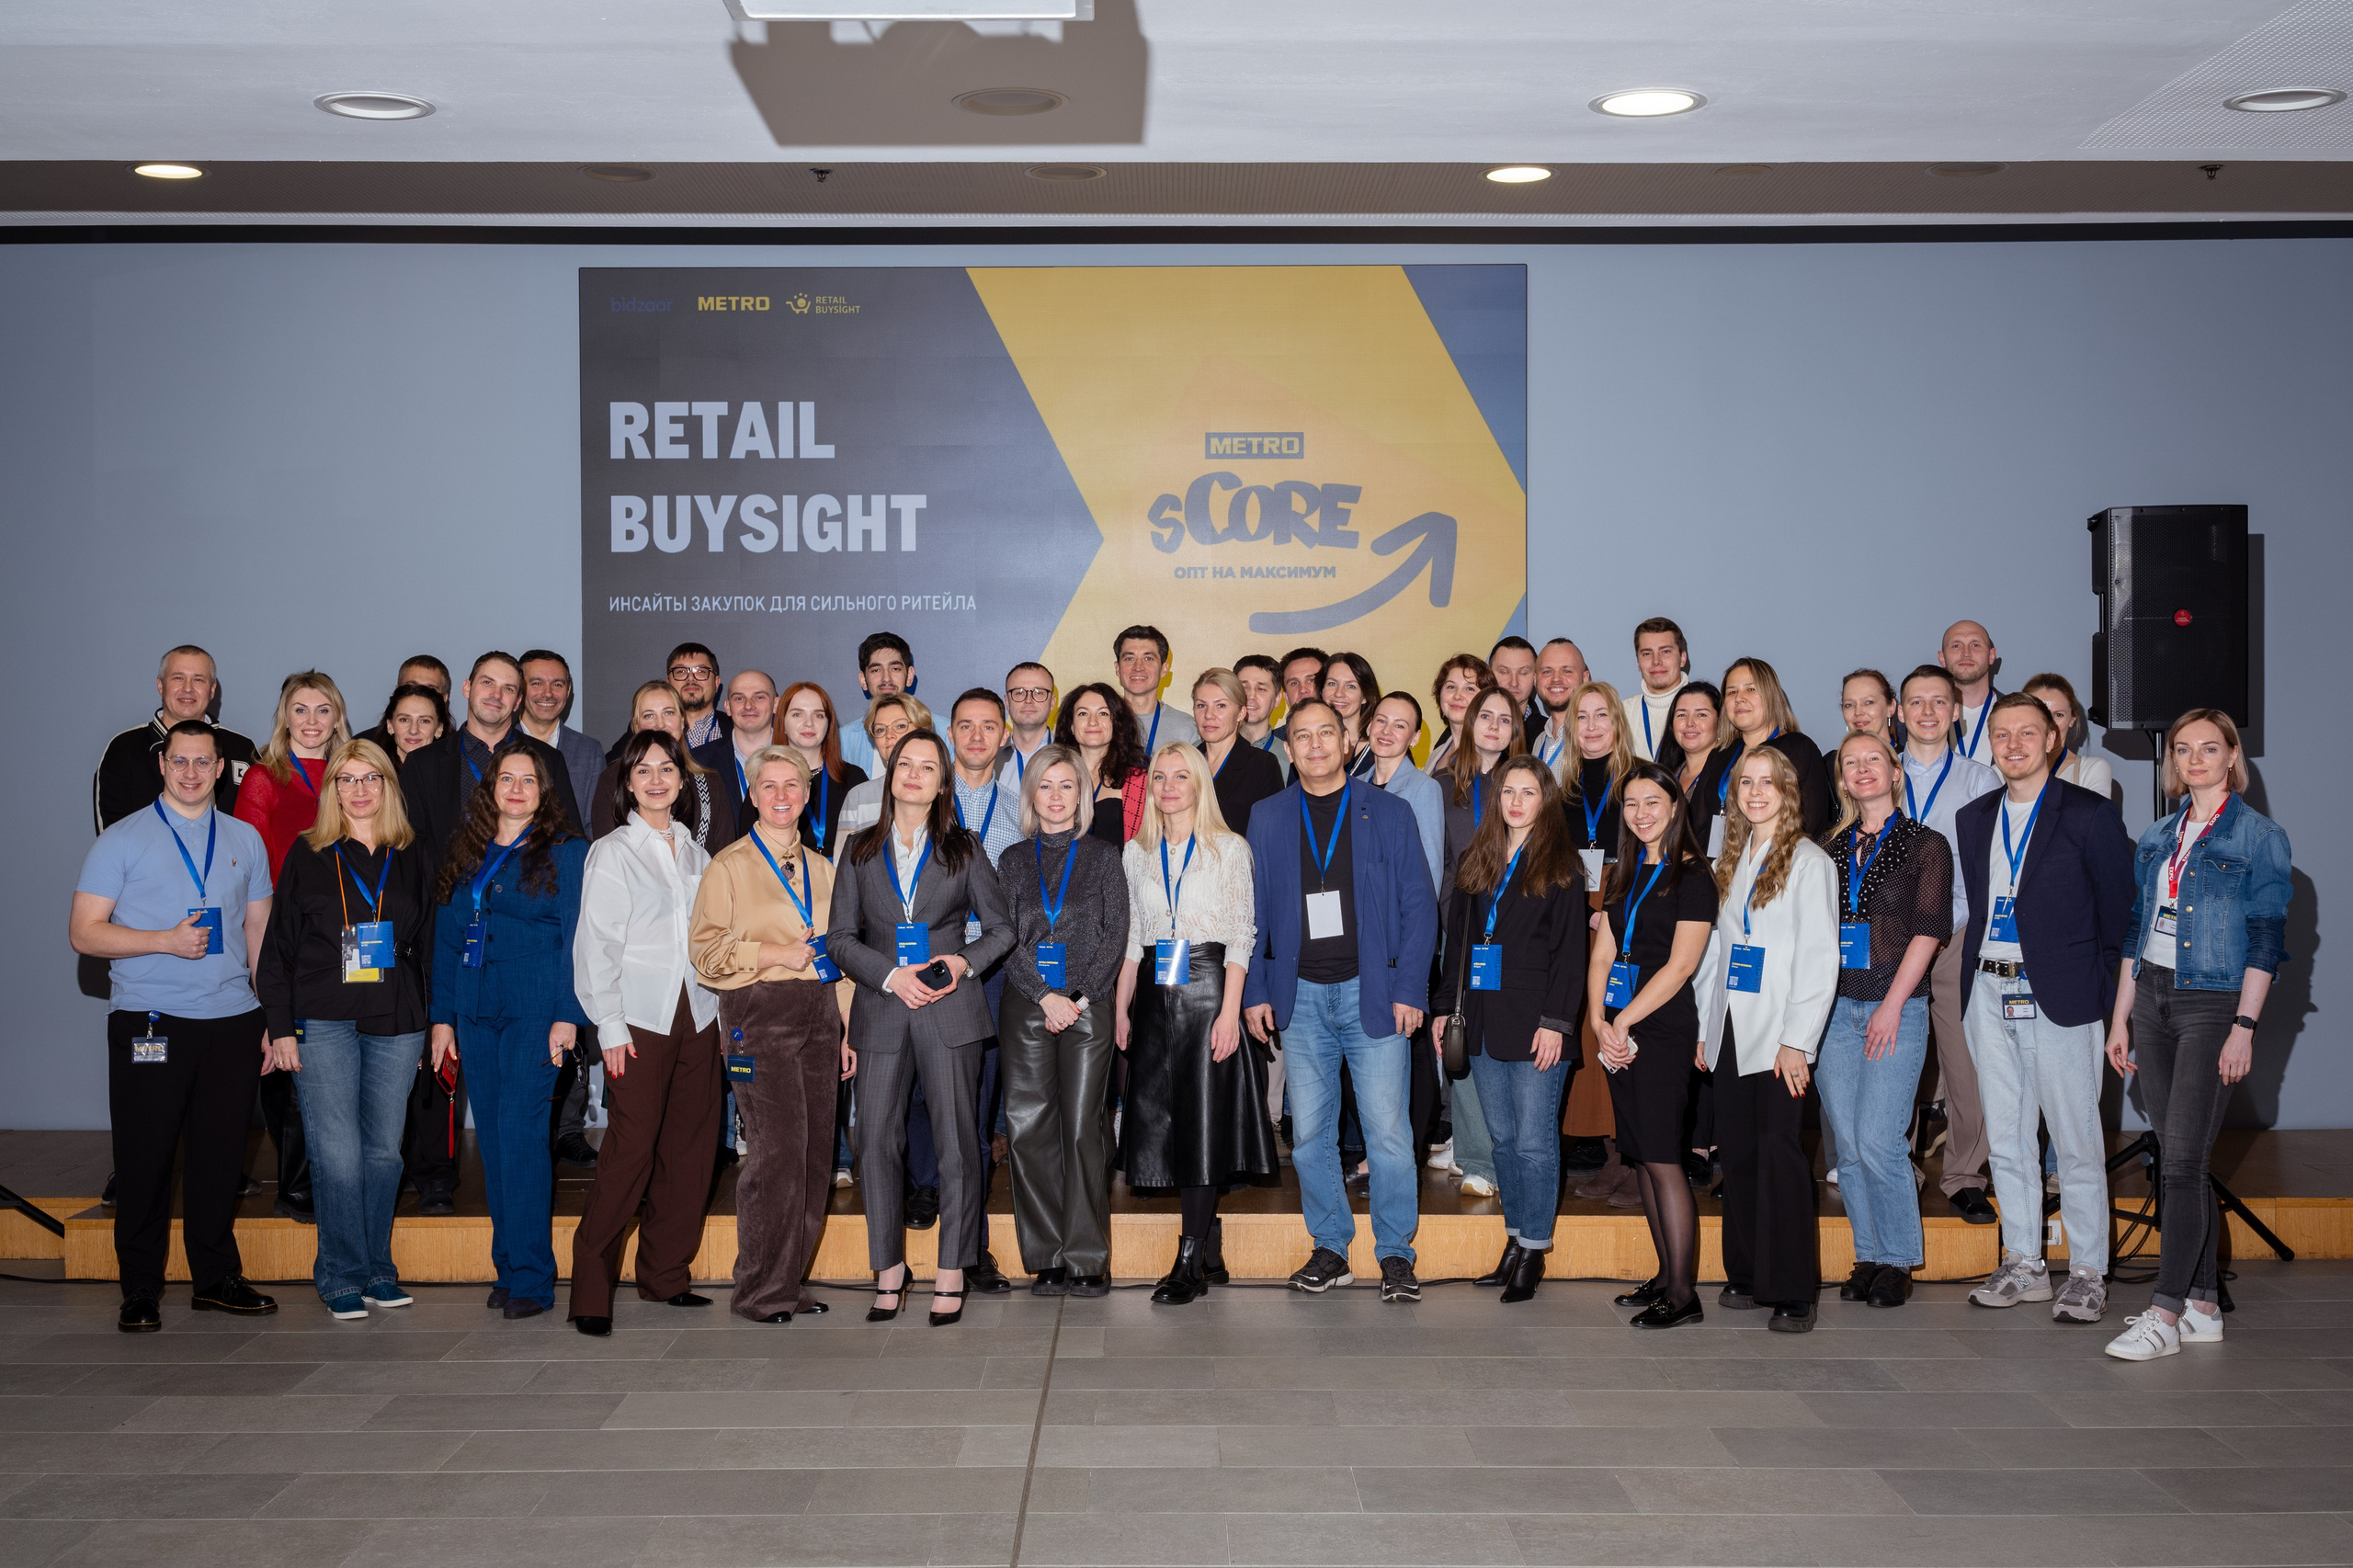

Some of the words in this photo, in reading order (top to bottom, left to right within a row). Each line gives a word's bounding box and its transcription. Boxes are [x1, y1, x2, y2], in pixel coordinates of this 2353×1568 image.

[611, 296, 673, 312] bidzaar
[698, 296, 770, 311] METRO
[815, 296, 847, 304] RETAIL
[609, 402, 835, 459] RETAIL
[1210, 437, 1300, 454] METRO
[610, 494, 926, 553] BUYSIGHT
[1174, 566, 1208, 579] ОПТ
[1212, 566, 1236, 579] НА
[1240, 566, 1336, 579] МАКСИМУМ
[609, 593, 687, 611] ИНСАЙТЫ
[691, 596, 766, 611] ЗАКУПОК
[769, 597, 806, 613] ДЛЯ
[811, 596, 897, 611] СИЛЬНОГО
[902, 592, 977, 610] РИТЕЙЛА
[2209, 813, 2221, 826] EXPO
